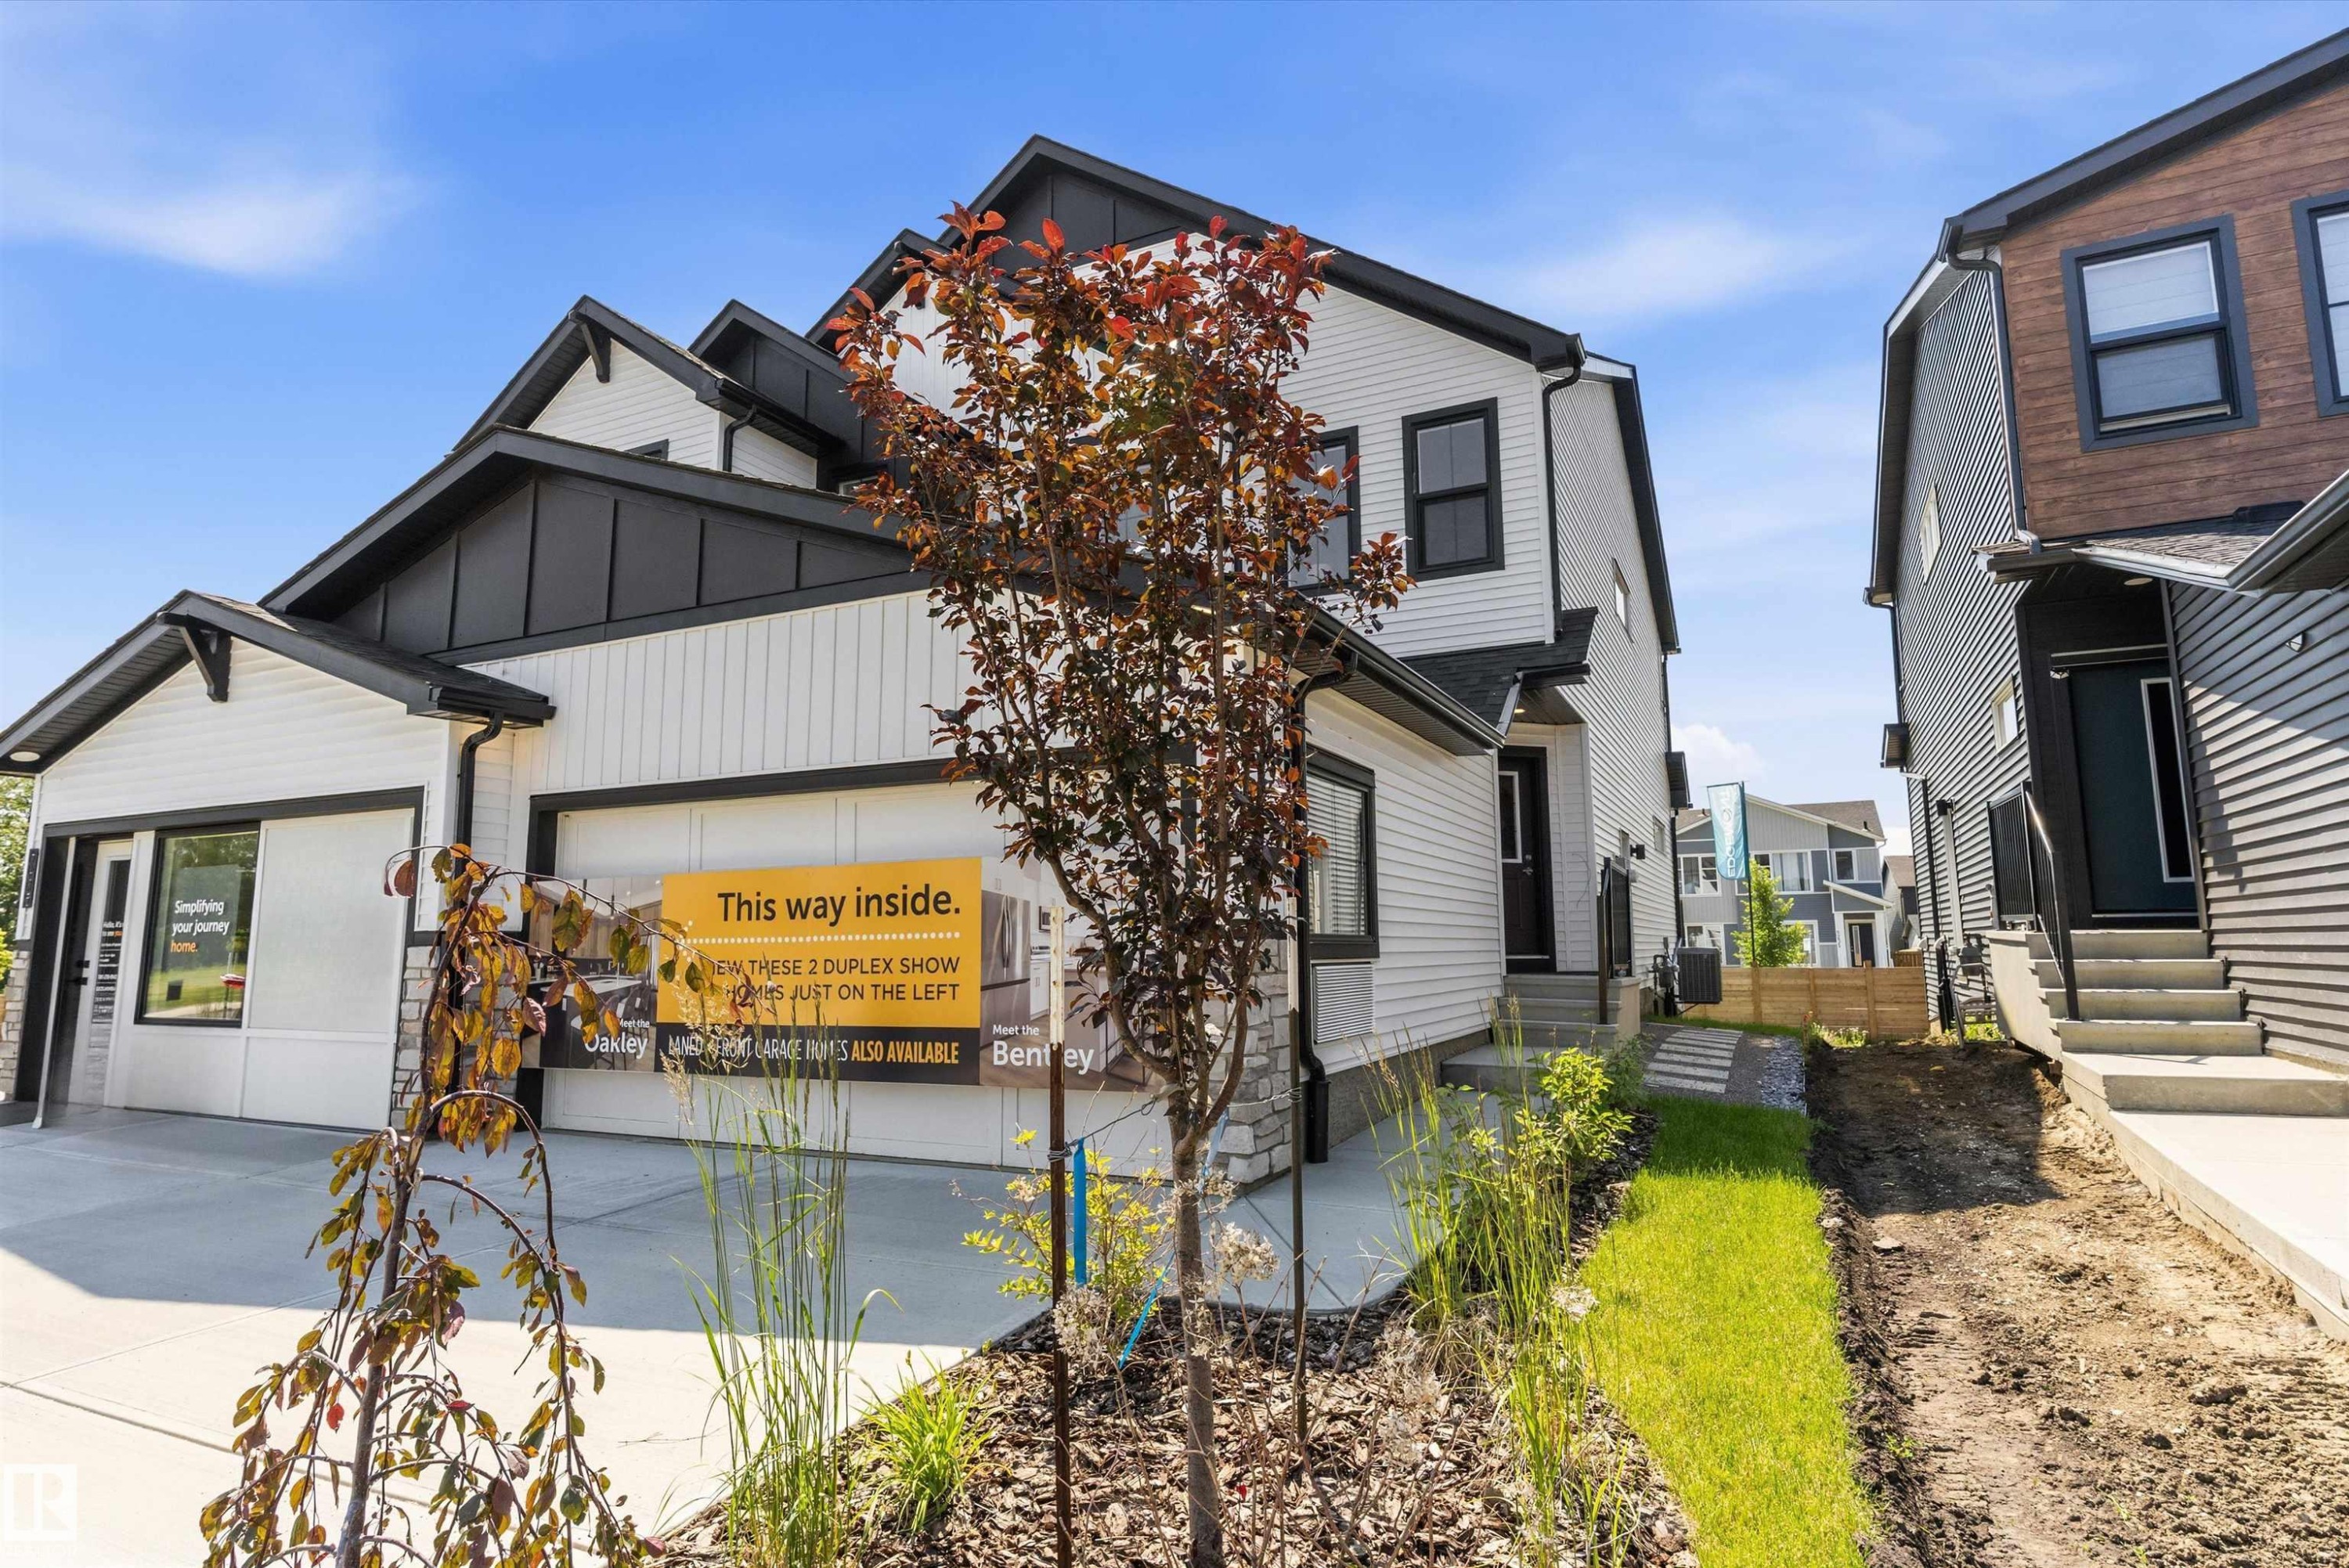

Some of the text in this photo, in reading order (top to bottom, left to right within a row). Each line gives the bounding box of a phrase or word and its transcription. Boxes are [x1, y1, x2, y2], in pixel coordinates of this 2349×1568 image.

[174, 899, 225, 917] Simplifying
[717, 884, 960, 927] This way inside.
[171, 919, 230, 937] your journey
[170, 939, 198, 953] home.
[749, 960, 802, 975] THESE
[809, 959, 817, 975] 2
[824, 957, 893, 974] DUPLEX
[900, 957, 960, 974] SHOW
[790, 984, 832, 1000] JUST
[838, 984, 864, 1000] ON
[871, 984, 906, 1000] THE
[913, 983, 960, 1000] LEFT
[637, 1018, 650, 1028] the
[992, 1025, 1040, 1035] Meet the
[584, 1031, 648, 1059] Oakley
[851, 1040, 884, 1062] ALSO
[886, 1040, 959, 1064] AVAILABLE
[993, 1040, 1095, 1075] Bentey
